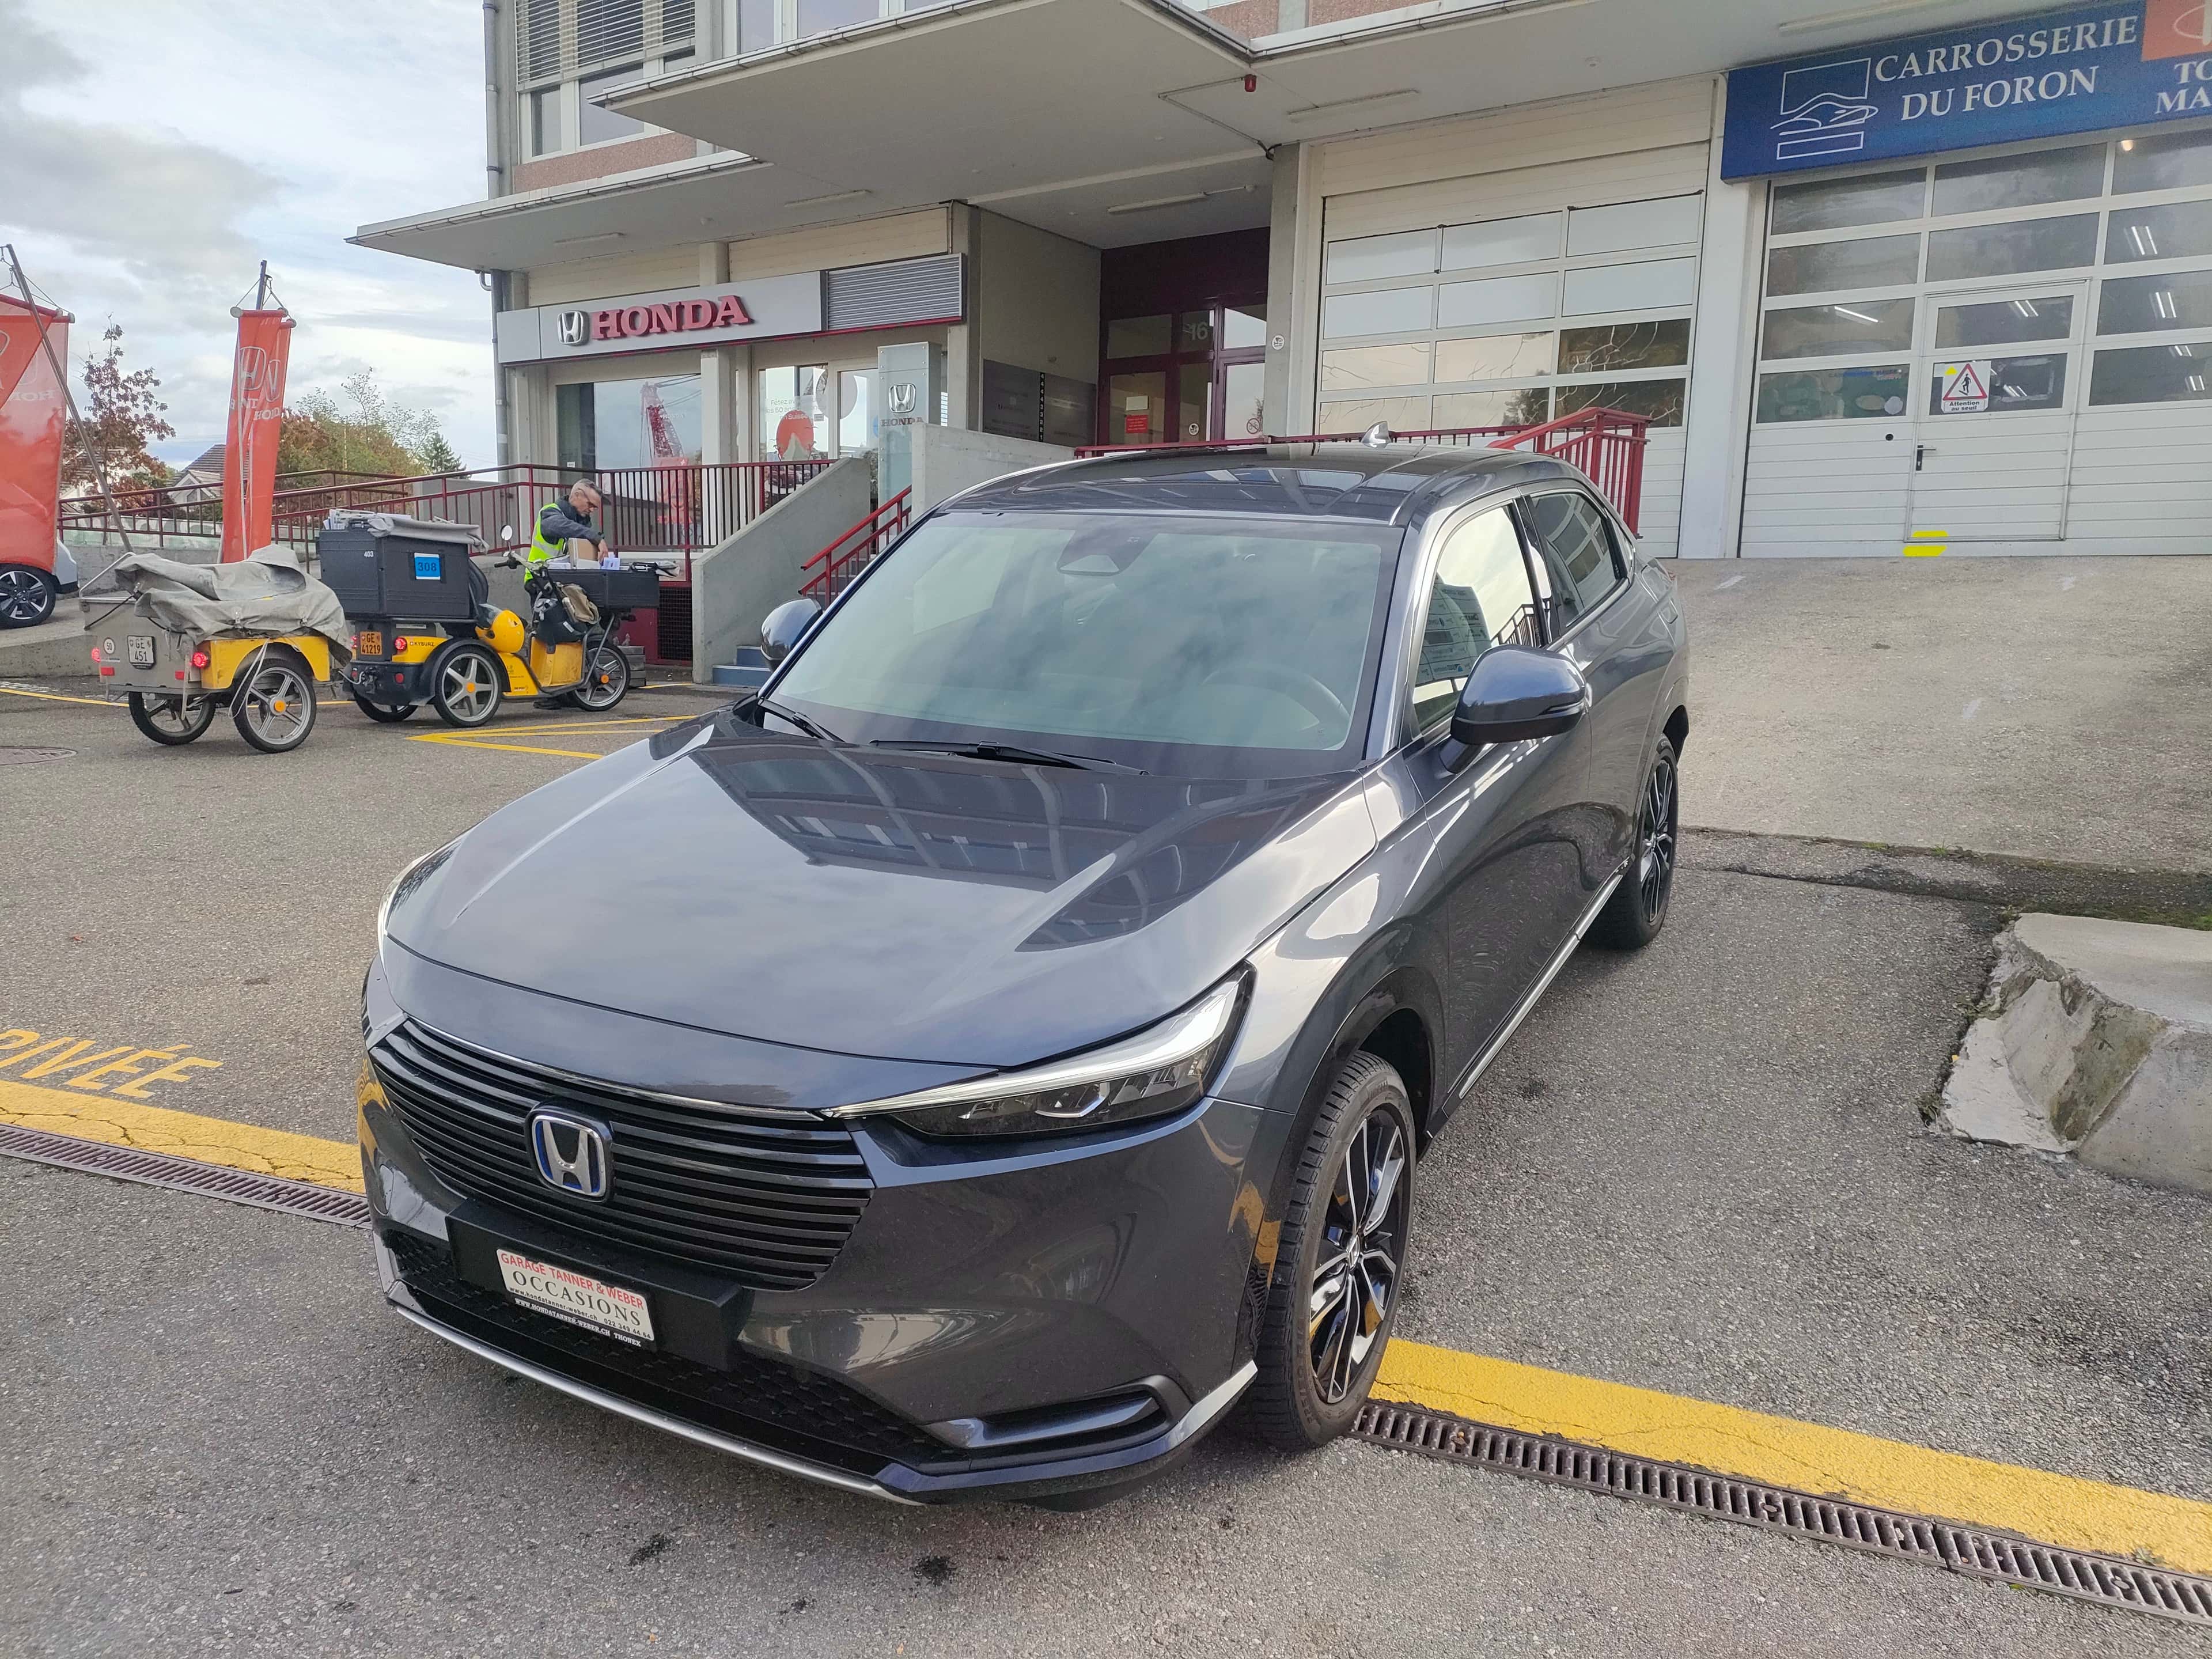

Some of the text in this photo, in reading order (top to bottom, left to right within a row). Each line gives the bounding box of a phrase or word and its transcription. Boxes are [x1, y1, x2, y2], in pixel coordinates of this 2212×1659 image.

[1875, 16, 2138, 82] CARROSSERIE
[1902, 66, 2099, 120] DU FORON
[590, 295, 753, 340] HONDA
[1189, 321, 1208, 340] 16
[881, 417, 923, 427] HONDA
[418, 562, 437, 571] 308
[135, 638, 145, 649] GE
[366, 633, 375, 643] GE
[107, 642, 112, 650] 50
[361, 645, 381, 654] 41219
[135, 651, 147, 661] 451
[501, 1253, 644, 1310] GARAGE TANNER & WEBER
[513, 1271, 640, 1326] OCCASIONS
[509, 1287, 597, 1321] www.hondatanner-weber.ch
[604, 1318, 616, 1327] 022
